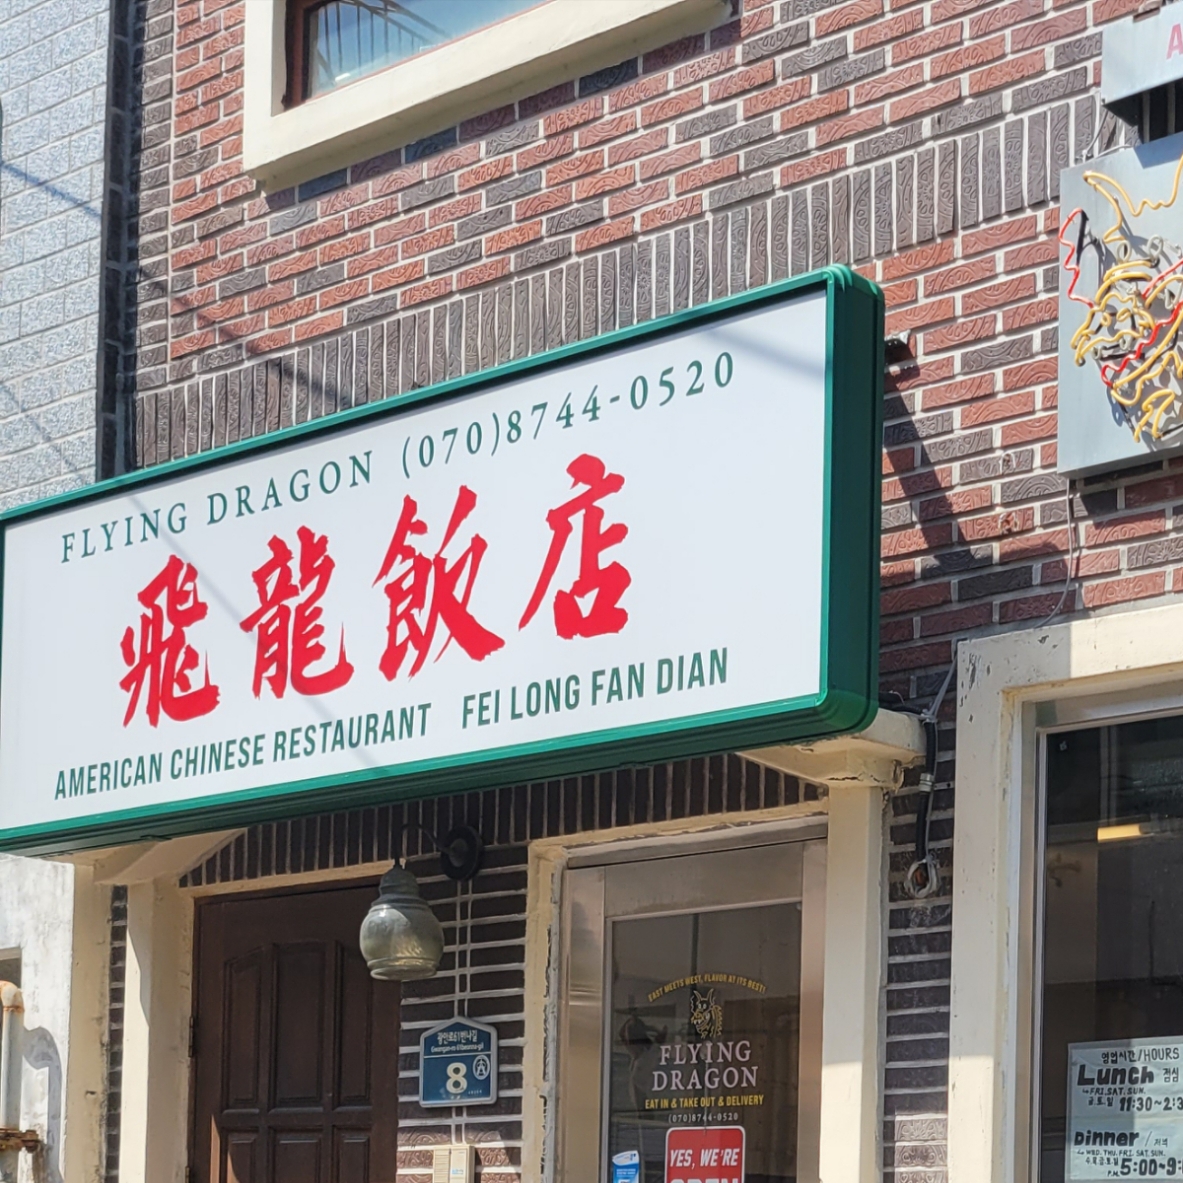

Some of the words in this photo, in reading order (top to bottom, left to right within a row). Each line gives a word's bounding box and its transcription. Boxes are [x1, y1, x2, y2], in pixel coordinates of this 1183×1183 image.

[61, 501, 190, 564] FLYING
[206, 450, 374, 526] DRAGON
[402, 350, 736, 480] (070)8744-0520
[119, 452, 632, 728] 飛龍飯店
[54, 741, 164, 801] AMERICAN
[169, 729, 269, 784] CHINESE
[272, 701, 433, 764] RESTAURANT
[461, 686, 501, 729] FEI
[509, 674, 582, 721] LONG
[591, 662, 646, 704] FAN
[656, 646, 729, 696] DIAN
[704, 973, 727, 982] FLAVOR
[659, 1040, 752, 1065] FLYING
[446, 1062, 467, 1094] 8
[652, 1066, 758, 1091] DRAGON
[1077, 1064, 1154, 1086] Lunch
[1163, 1067, 1179, 1083] 점심
[645, 1098, 660, 1109] EAT
[660, 1099, 669, 1109] IN
[671, 1098, 677, 1108] &
[680, 1097, 698, 1108] TAKE
[700, 1097, 715, 1108] OUT
[718, 1096, 724, 1107] &
[726, 1095, 764, 1107] DELIVERY
[668, 1112, 738, 1123] (070)8744-0520
[1074, 1130, 1140, 1146] Dinner
[1154, 1138, 1168, 1148] 저녁
[669, 1149, 695, 1169] YES,
[700, 1148, 740, 1167] WE'RE
